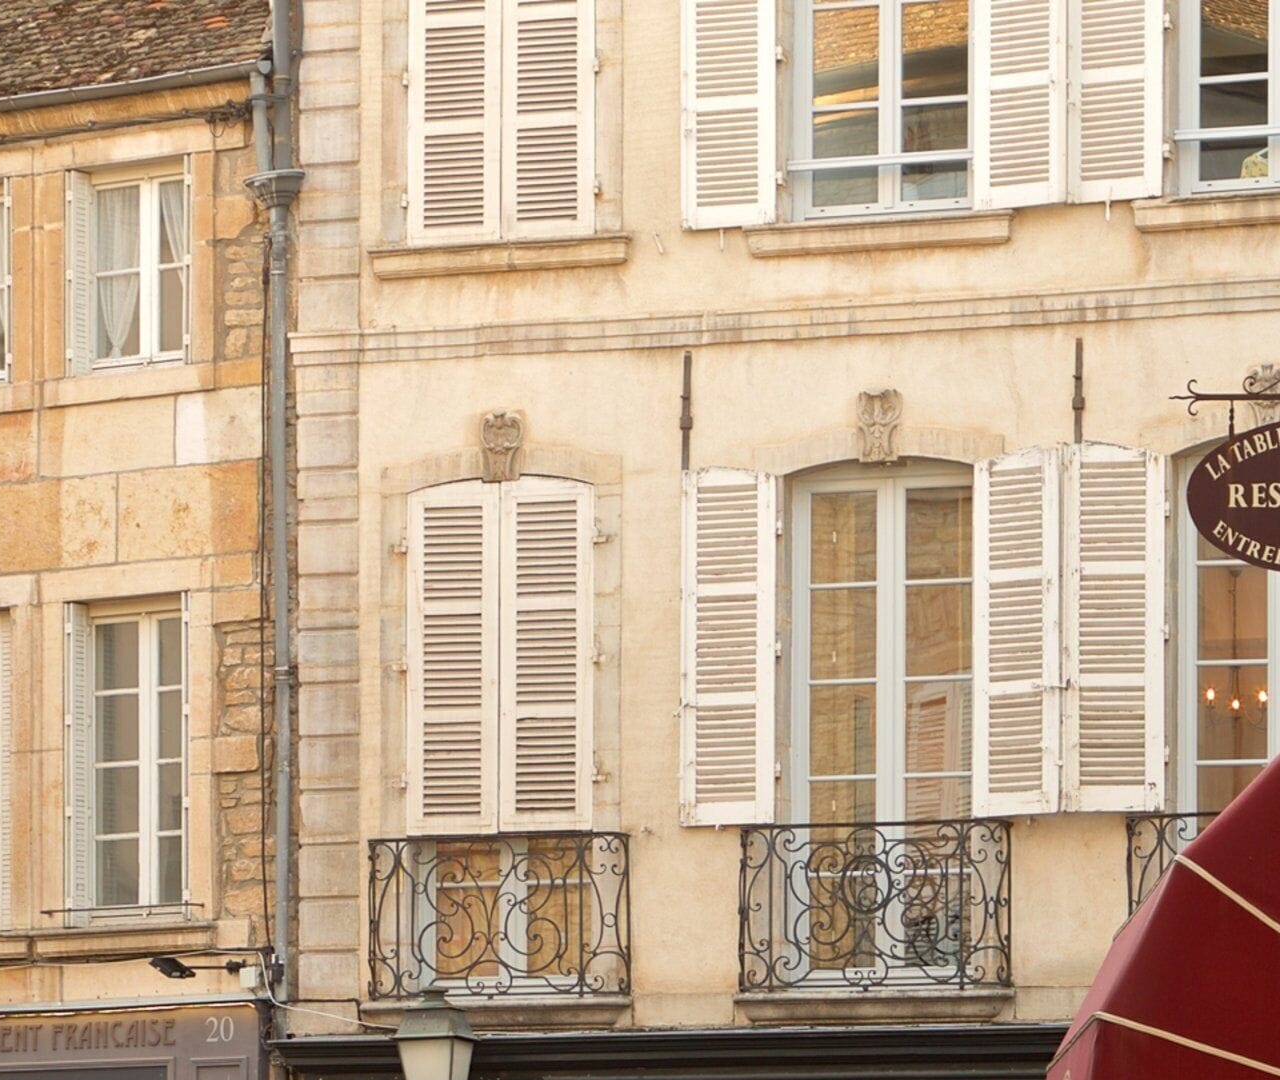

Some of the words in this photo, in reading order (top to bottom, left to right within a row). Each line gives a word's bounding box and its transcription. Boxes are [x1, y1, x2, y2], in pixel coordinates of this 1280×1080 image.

[1204, 449, 1232, 481] LA
[51, 1018, 176, 1051] FRANÇAISE
[205, 1016, 234, 1043] 20
